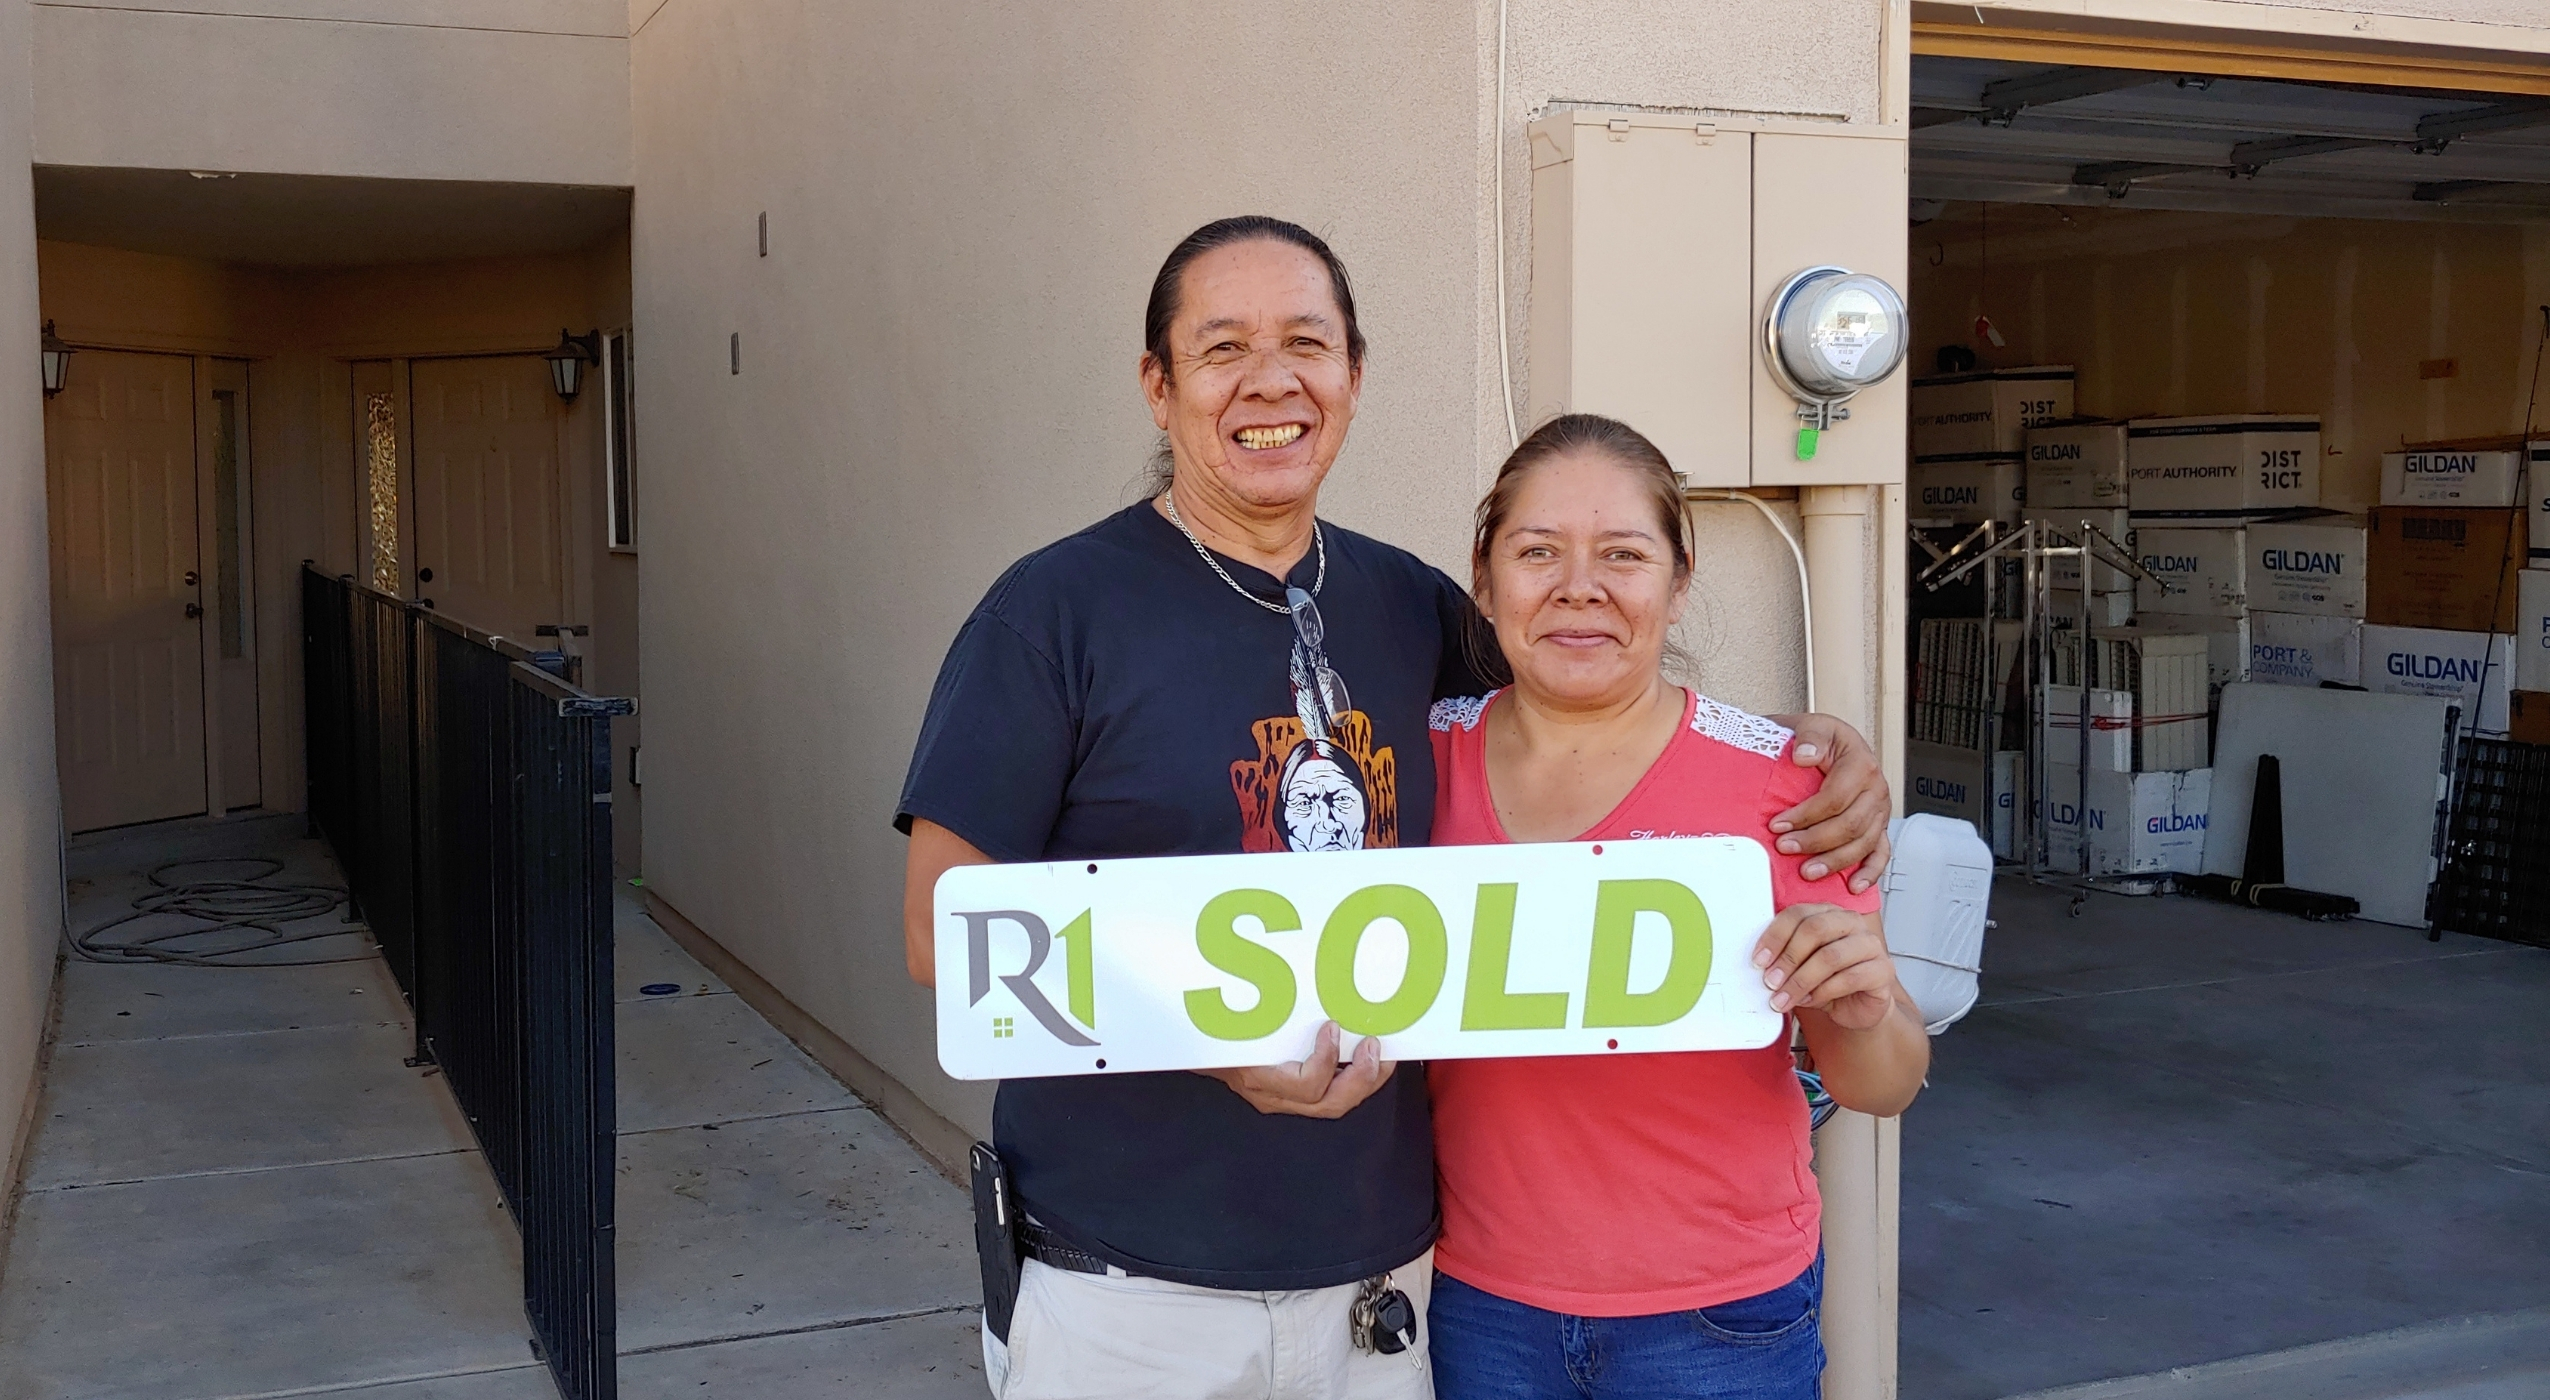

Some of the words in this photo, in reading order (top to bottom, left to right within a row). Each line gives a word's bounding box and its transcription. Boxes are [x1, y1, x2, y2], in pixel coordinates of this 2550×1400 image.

[2020, 400, 2056, 415] DIST
[1935, 409, 1992, 425] AUTHORITY
[2031, 444, 2080, 461] GILDAN
[2261, 450, 2301, 468] DIST
[2131, 467, 2161, 480] PORT
[2163, 466, 2237, 479] AUTHORITY
[2405, 455, 2475, 473] GILDAN
[2261, 472, 2301, 489] RICT
[1922, 486, 1977, 504] GILDAN
[2142, 555, 2197, 573] GILDAN
[2263, 549, 2341, 575] GILDAN
[2253, 644, 2297, 663] PORT
[2299, 648, 2313, 664] &
[2252, 660, 2313, 679] COMPANY
[2387, 653, 2478, 683] GILDAN
[1916, 776, 1965, 804] GILDAN
[2147, 814, 2207, 834] GILDAN
[1182, 877, 1715, 1042] SOLD
